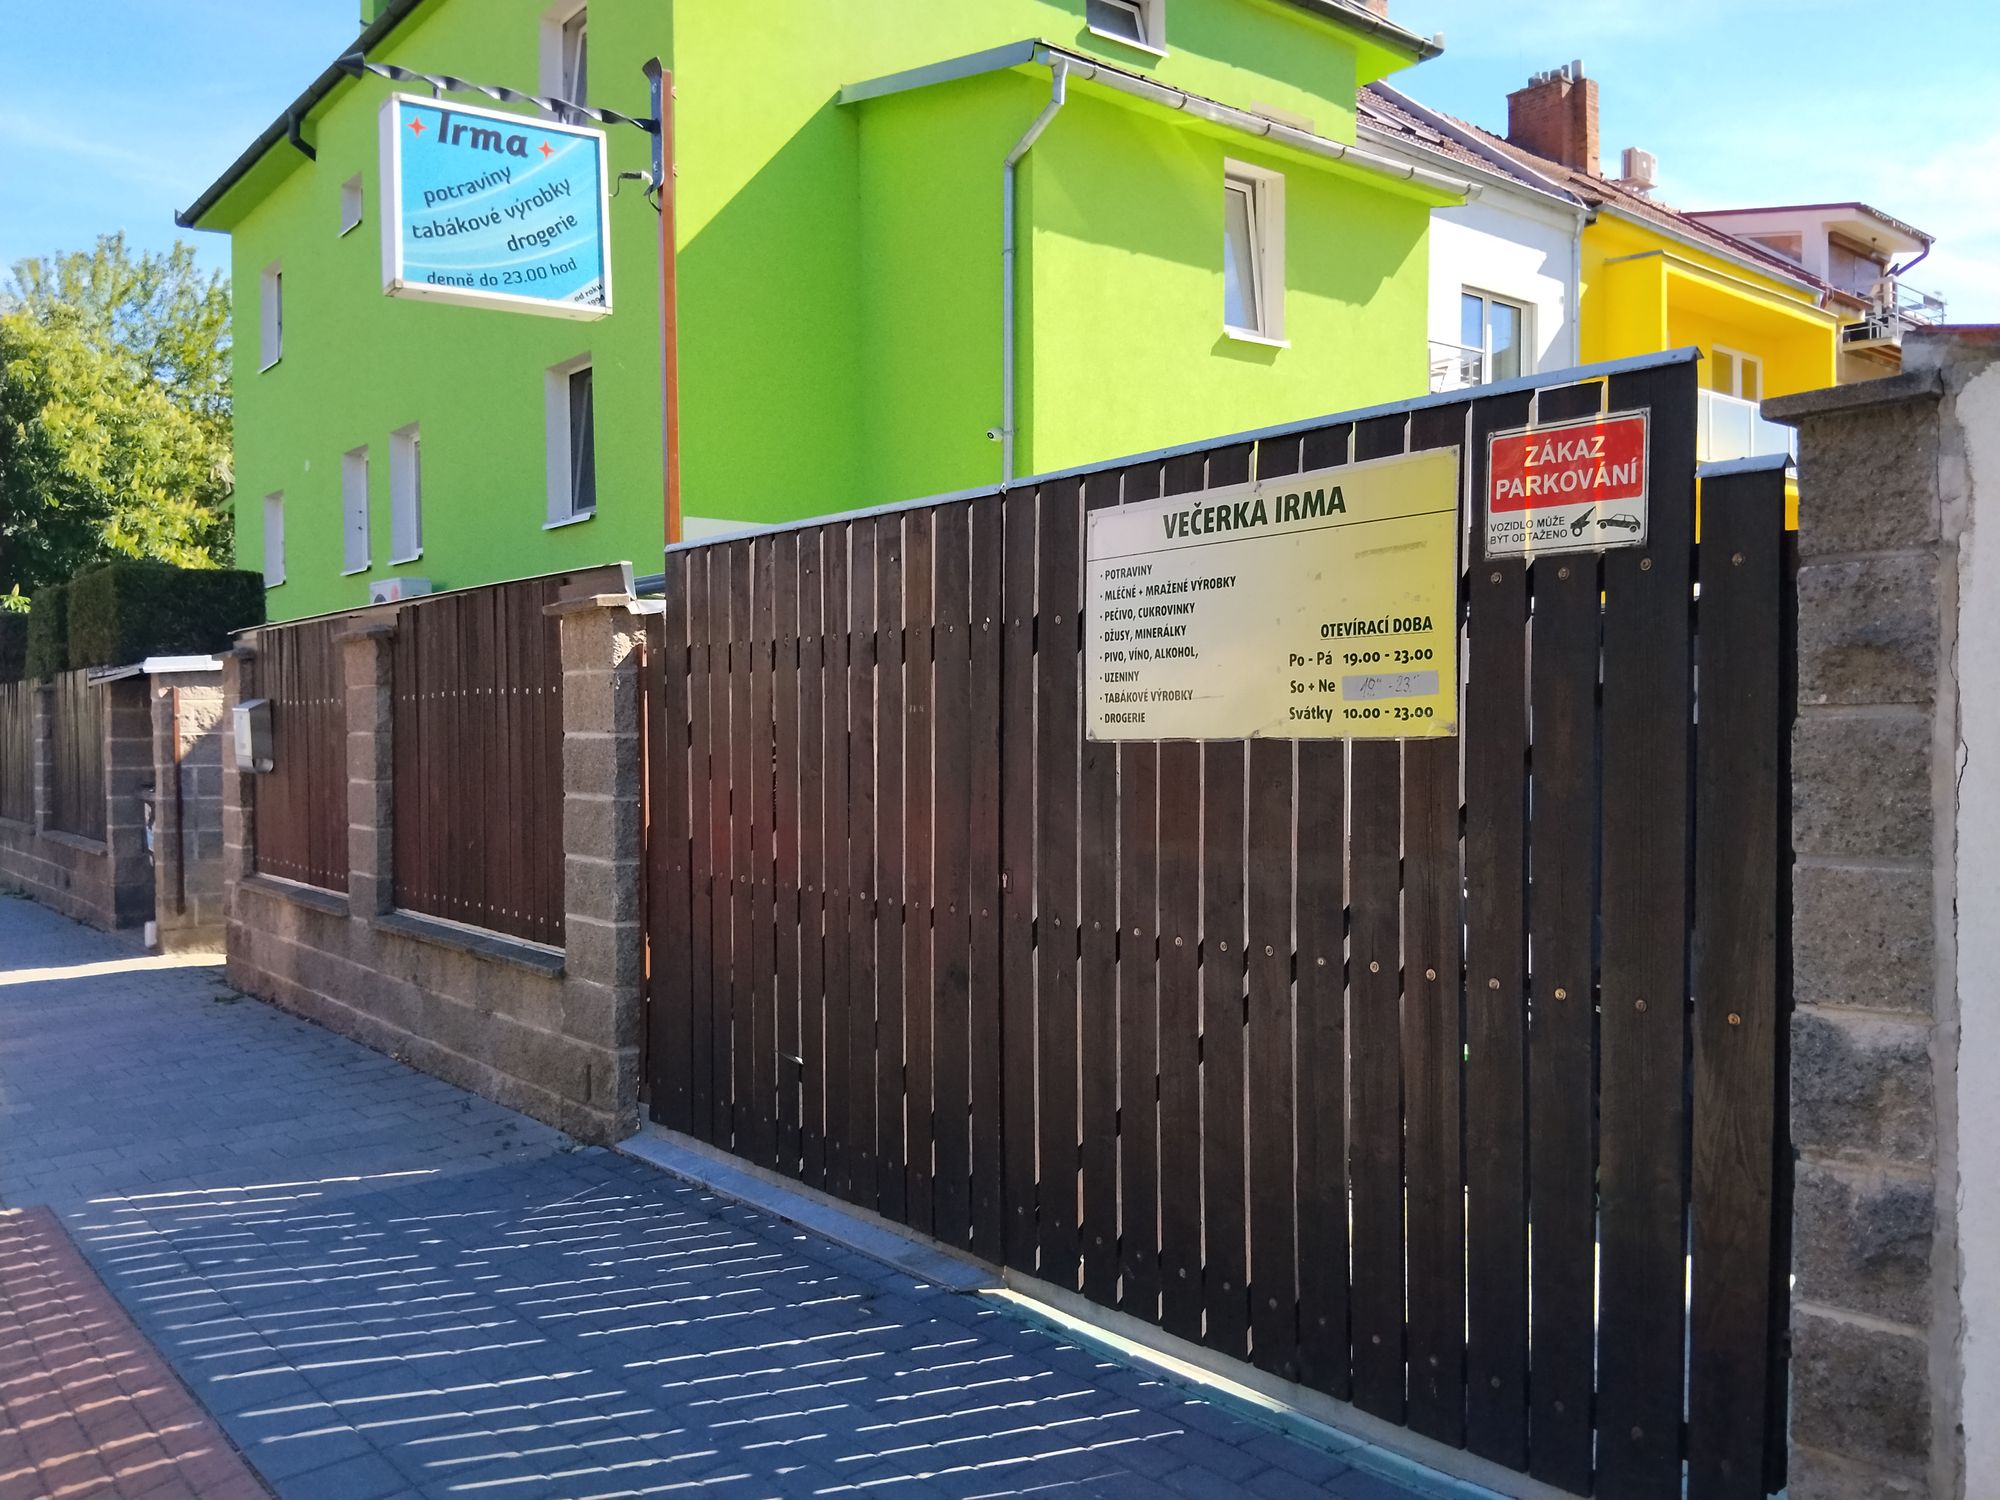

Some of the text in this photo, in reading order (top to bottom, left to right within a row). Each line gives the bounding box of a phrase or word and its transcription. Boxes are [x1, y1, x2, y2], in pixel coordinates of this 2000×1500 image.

[438, 111, 529, 158] Irma
[423, 166, 511, 208] potraviny
[412, 178, 571, 239] tabákové výrobky
[507, 214, 578, 252] drogerie
[427, 257, 577, 287] denně do 23.00 hod
[1524, 435, 1606, 468] ZÁKAZ
[1496, 457, 1638, 500] PARKOVÁNÍ
[1162, 485, 1347, 540] VEČERKA IRMA
[1490, 516, 1565, 532] VOZIDLO MŮŽE
[1490, 528, 1568, 545] BÝT ODTAŽENO
[1105, 564, 1153, 580] POTRAVINY
[1104, 585, 1136, 601] MLÉČNÉ
[1145, 580, 1188, 597] MRAŽENÉ
[1190, 575, 1236, 592] VÝROBKY
[1104, 602, 1195, 621] PEČIVO, CUKROVINKY
[1104, 623, 1187, 642] DŽUSY, MINERÁLKY
[1320, 615, 1433, 638] OTEVÍRACÍ DOBA
[1104, 646, 1198, 664] PIVO, VÍNO, ALKOHOL,
[1289, 653, 1305, 667] Po
[1316, 650, 1333, 666] Pá
[1343, 651, 1380, 666] 19.00
[1394, 649, 1433, 664] 23.00
[1104, 671, 1140, 683] UZENINY
[1290, 680, 1305, 693] So
[1318, 678, 1336, 693] Ne
[1104, 688, 1193, 703] TABÁKOVÉ VÝROBKY
[1104, 712, 1146, 724] DROGERIE
[1289, 705, 1333, 723] Svátky
[1343, 708, 1380, 719] 10.00
[1394, 706, 1434, 721] 23.00
